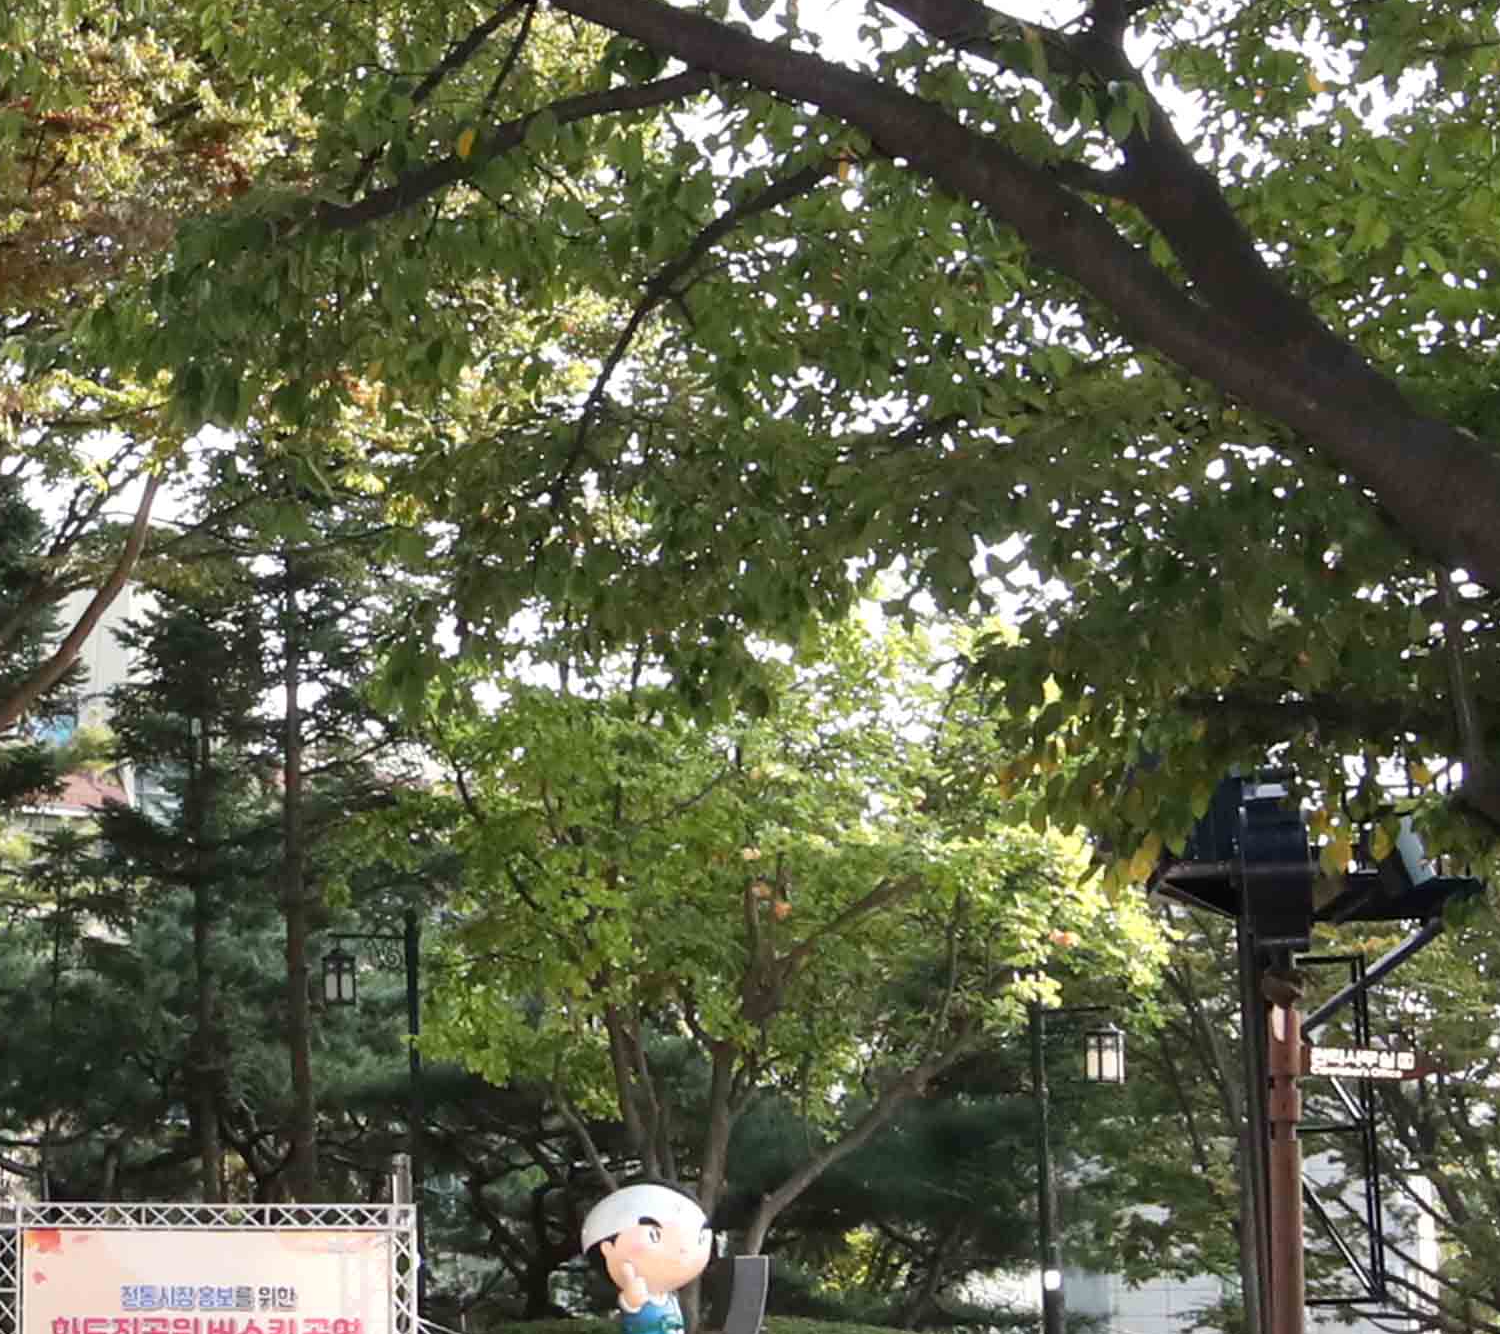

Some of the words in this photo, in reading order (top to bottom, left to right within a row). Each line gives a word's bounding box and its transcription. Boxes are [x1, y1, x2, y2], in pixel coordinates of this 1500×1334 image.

[119, 1285, 194, 1310] 전통시장
[198, 1285, 254, 1310] 홍보를
[257, 1285, 298, 1310] 위한
